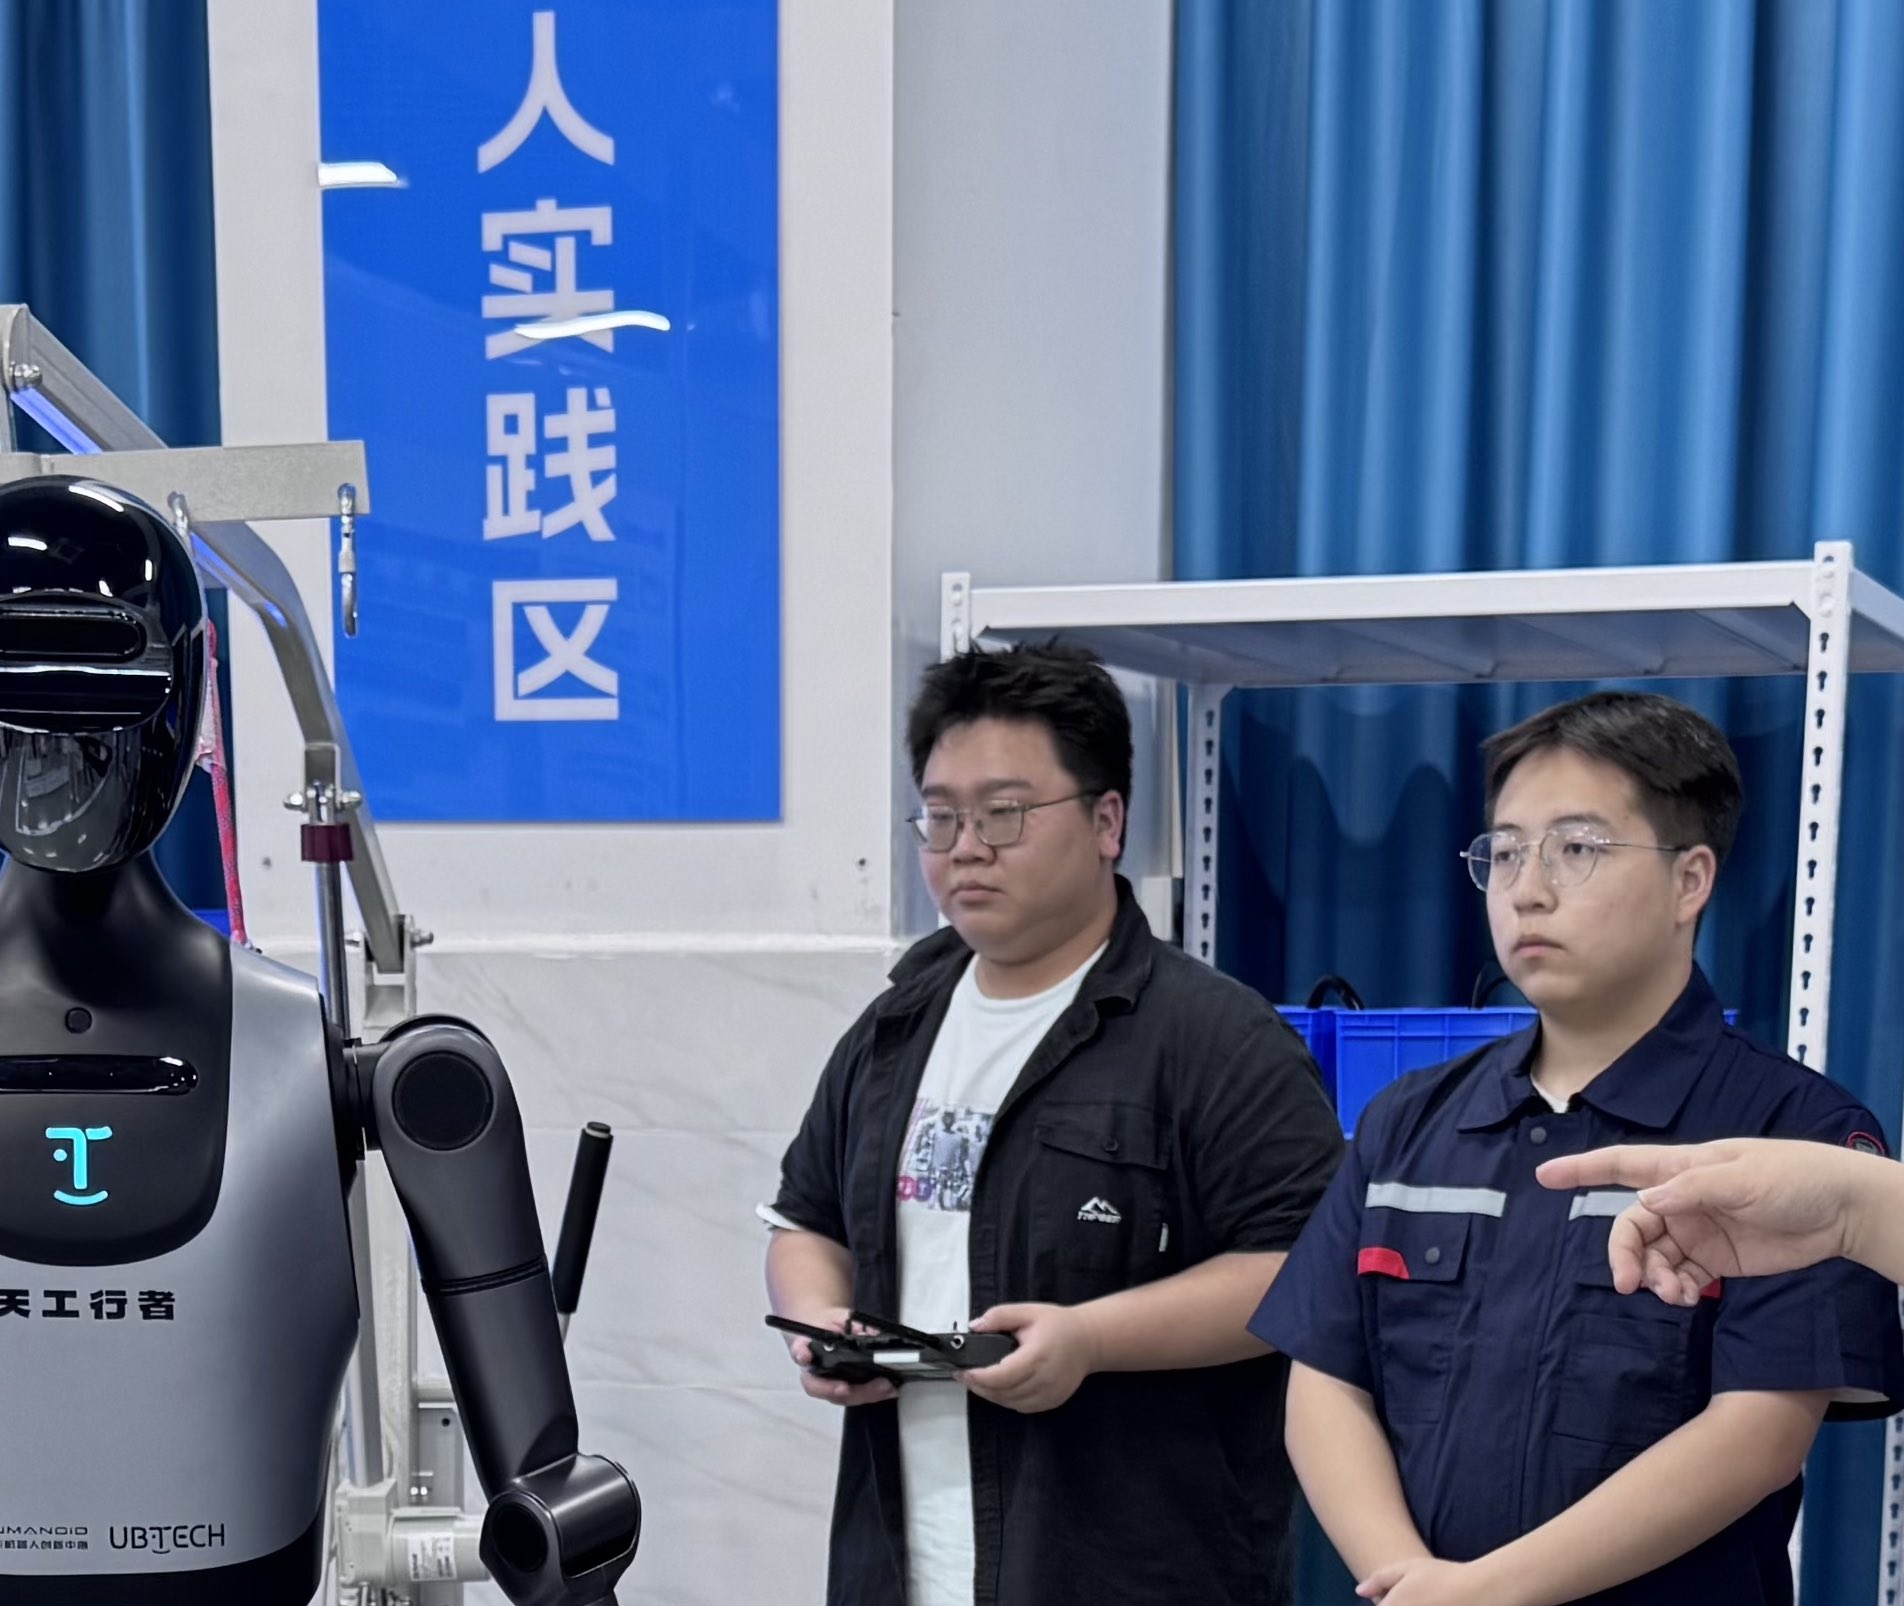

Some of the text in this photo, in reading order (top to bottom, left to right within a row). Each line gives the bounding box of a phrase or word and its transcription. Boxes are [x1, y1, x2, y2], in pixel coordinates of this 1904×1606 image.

[477, 10, 621, 722] 人实践区
[109, 1522, 226, 1555] UBTECH
